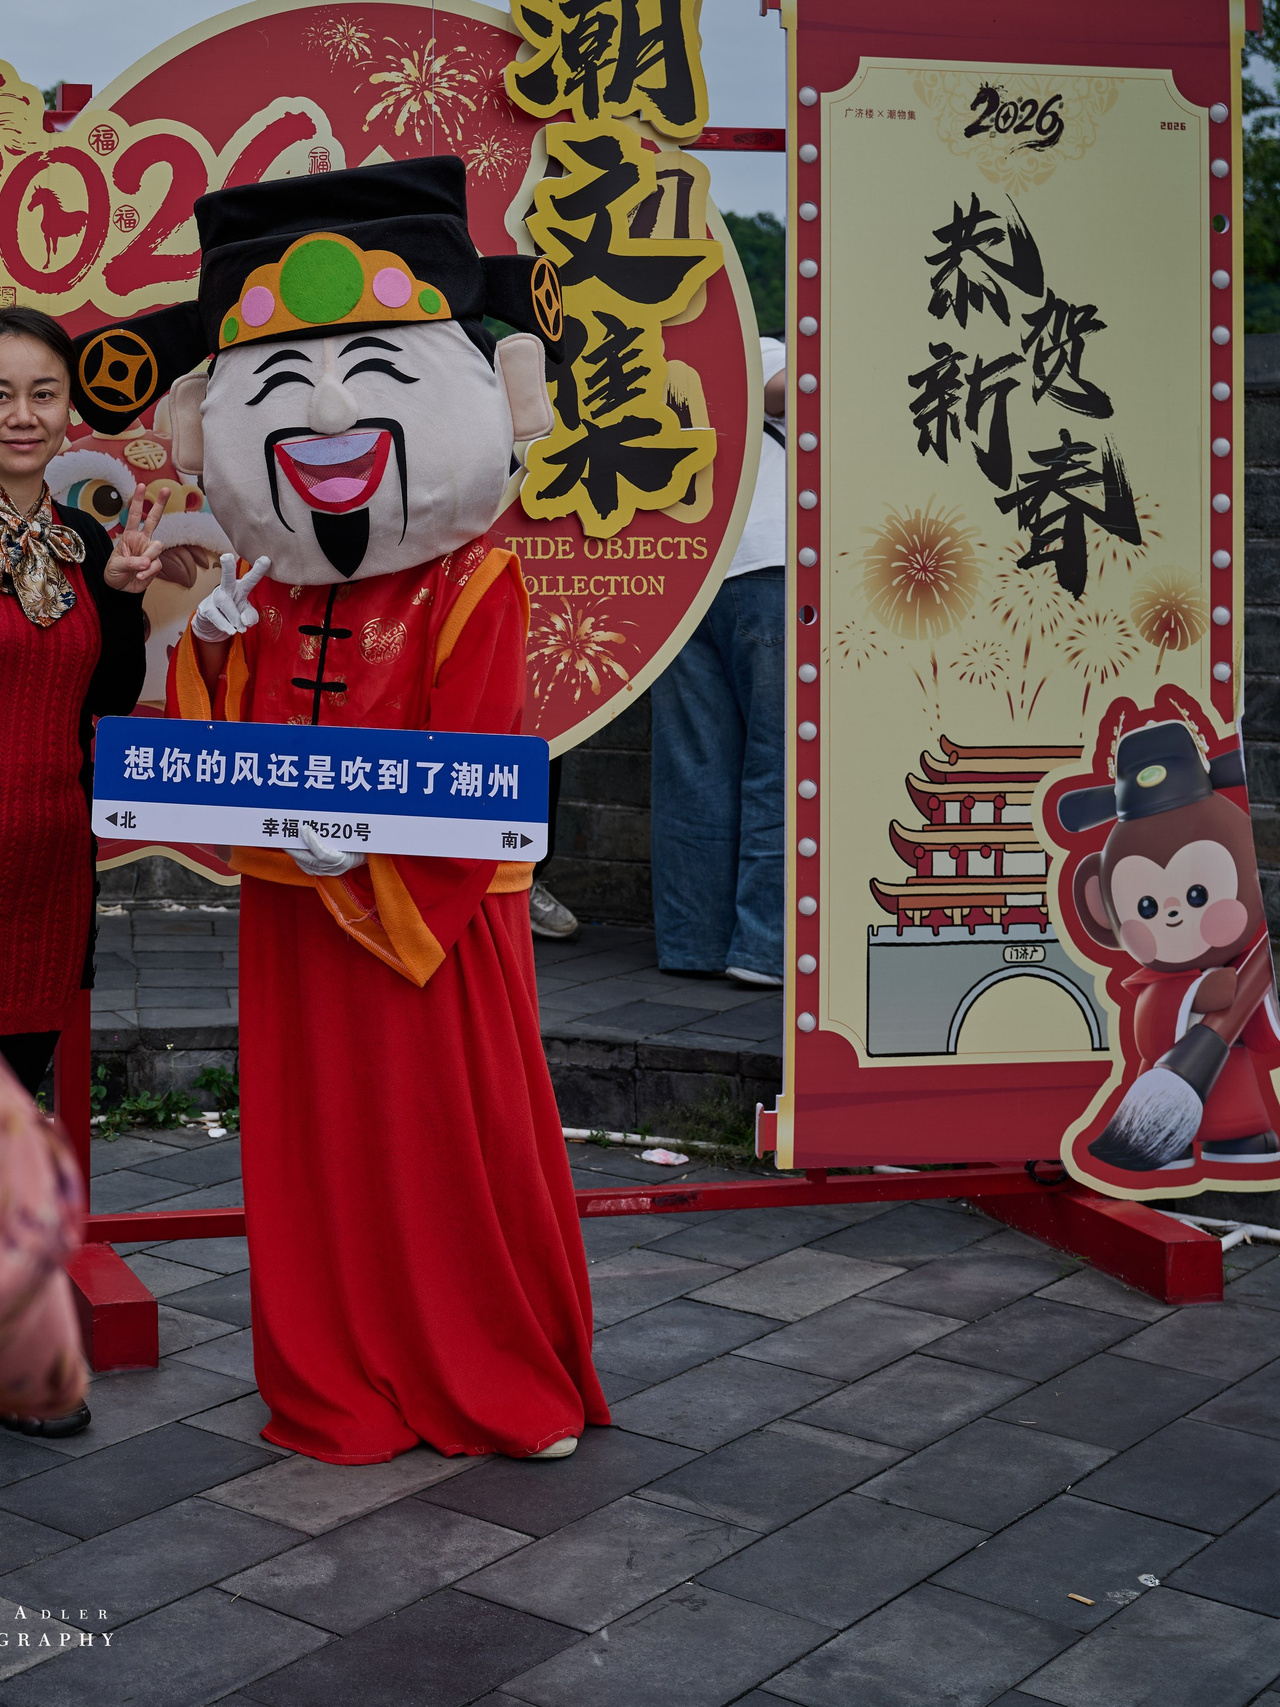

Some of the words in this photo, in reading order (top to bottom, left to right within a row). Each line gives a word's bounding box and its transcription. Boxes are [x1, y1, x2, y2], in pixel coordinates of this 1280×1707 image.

[845, 108, 874, 119] 广济楼
[887, 109, 916, 120] 潮物集
[964, 81, 1064, 152] 2026
[1160, 121, 1186, 131] 2026
[91, 128, 115, 152] 福
[115, 209, 136, 230] 福
[505, 536, 575, 559] TIDE
[583, 536, 708, 560] OBJECTS
[523, 575, 665, 596] OLLECTION
[123, 745, 519, 800] 想你的风还是吹到了潮州
[120, 811, 136, 829] 北
[501, 831, 518, 849] 南
